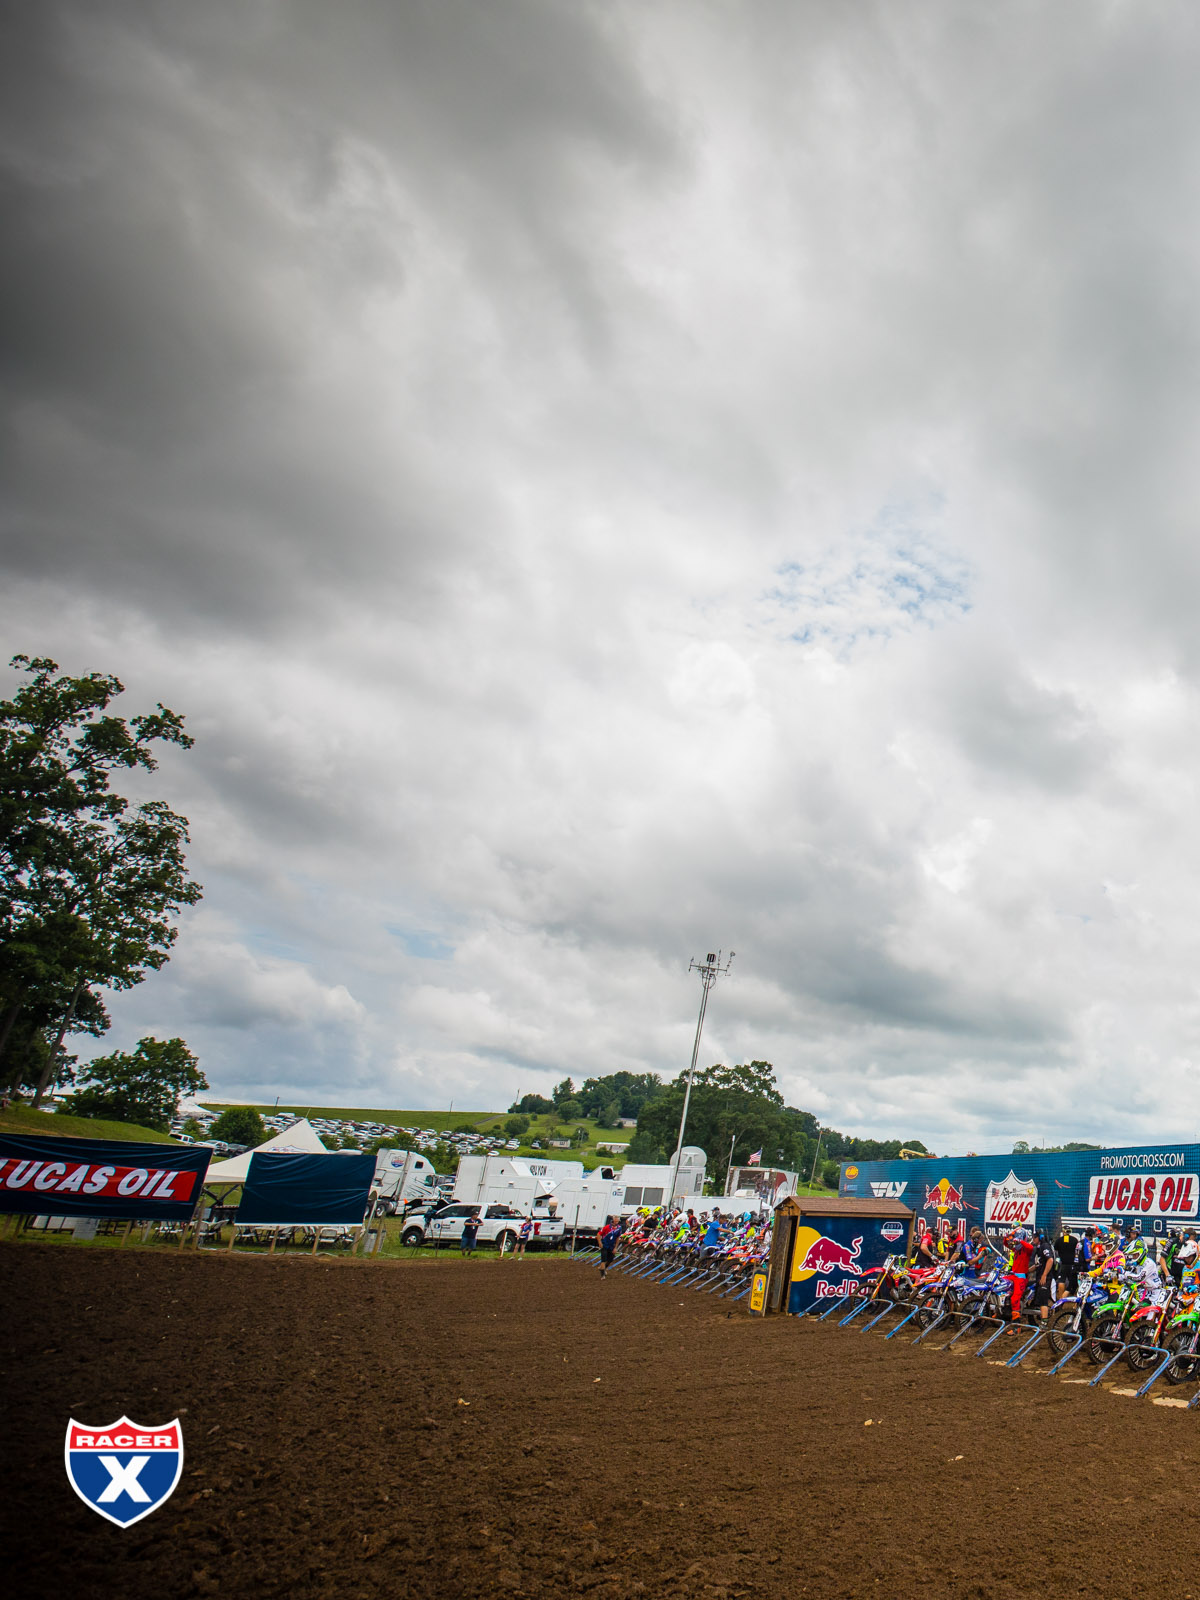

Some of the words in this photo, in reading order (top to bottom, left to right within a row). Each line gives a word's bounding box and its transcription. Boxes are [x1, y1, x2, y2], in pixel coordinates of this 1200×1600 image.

[1101, 1153, 1184, 1168] PROMOTOCROSS.COM
[117, 1168, 179, 1198] OIL
[1092, 1175, 1156, 1212] LUCAS
[1158, 1174, 1194, 1212] OIL
[989, 1200, 1034, 1223] LUCAS
[815, 1279, 846, 1298] Red
